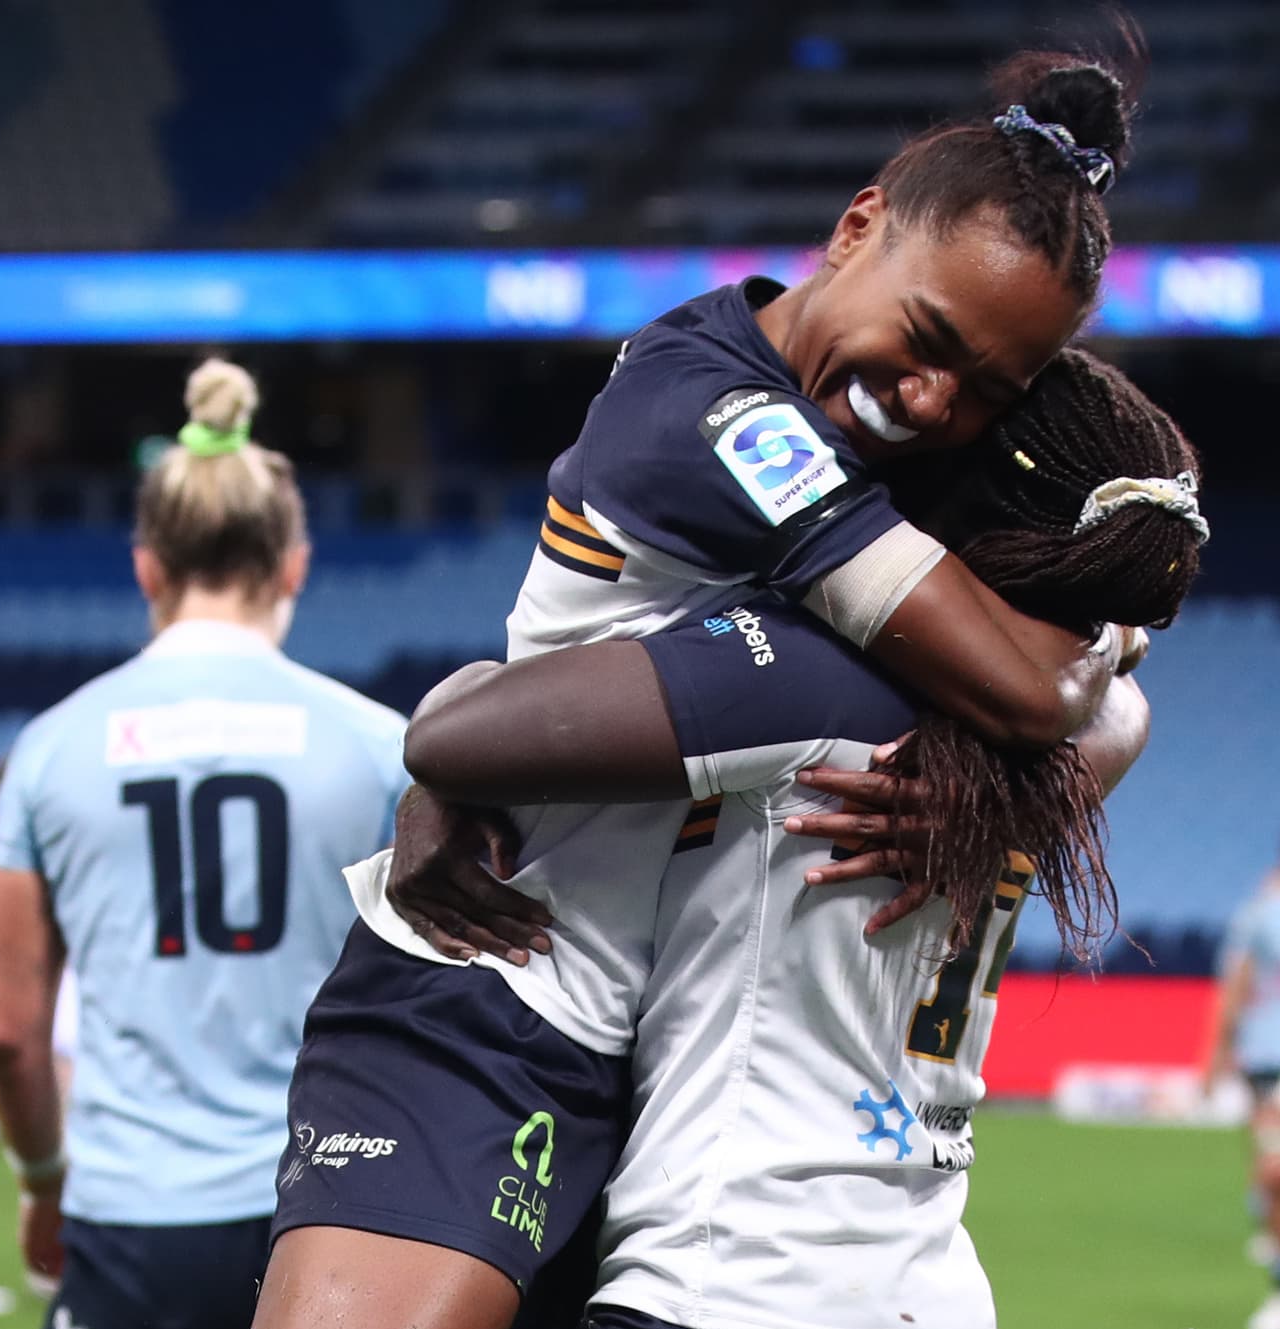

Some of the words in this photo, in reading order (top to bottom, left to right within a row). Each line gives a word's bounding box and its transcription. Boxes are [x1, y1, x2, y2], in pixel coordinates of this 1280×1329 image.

[706, 391, 770, 427] Buildcorp
[774, 483, 802, 508] SUPER
[802, 465, 827, 487] RUGBY
[120, 773, 290, 957] 10
[311, 1153, 349, 1169] Group
[315, 1132, 398, 1159] Vikings
[499, 1175, 548, 1227] CLUB
[491, 1195, 543, 1253] LIME
